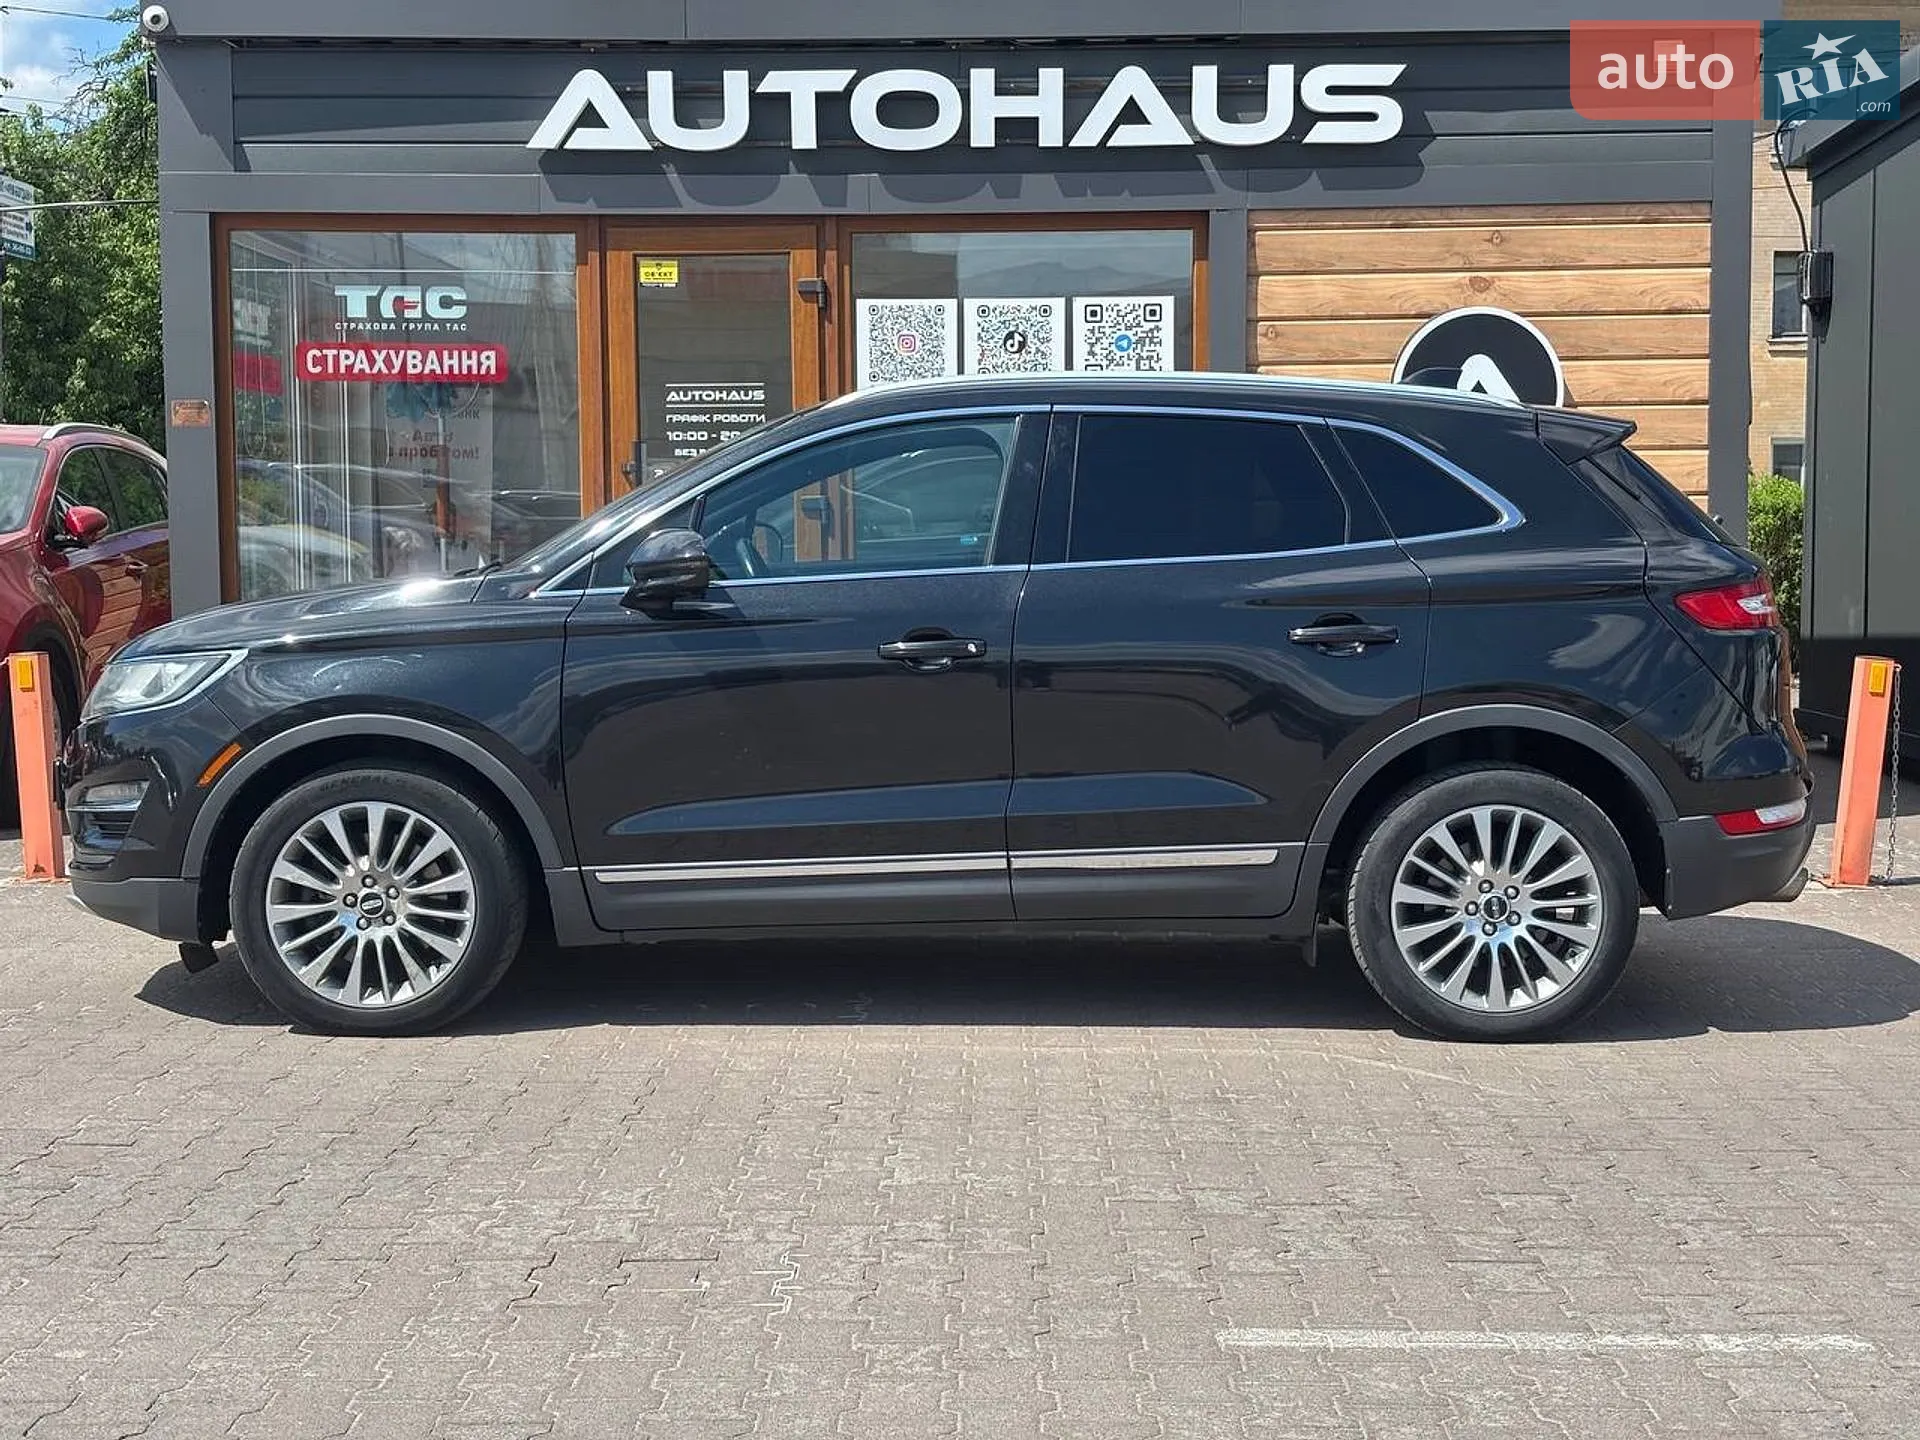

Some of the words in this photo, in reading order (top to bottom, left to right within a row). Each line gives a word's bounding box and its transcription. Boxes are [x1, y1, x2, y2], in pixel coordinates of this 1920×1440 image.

[526, 63, 1407, 152] AUTOHAUS
[334, 322, 396, 331] СТРАХОВА
[402, 322, 440, 331] ГРУПА
[446, 323, 468, 332] ТАС
[306, 349, 497, 375] СТРАХУВАННЯ
[666, 390, 765, 401] AUTOHAUS
[666, 414, 710, 423] ГРАФІК
[713, 414, 765, 423] РОБОТИ
[666, 431, 708, 441] 10:00
